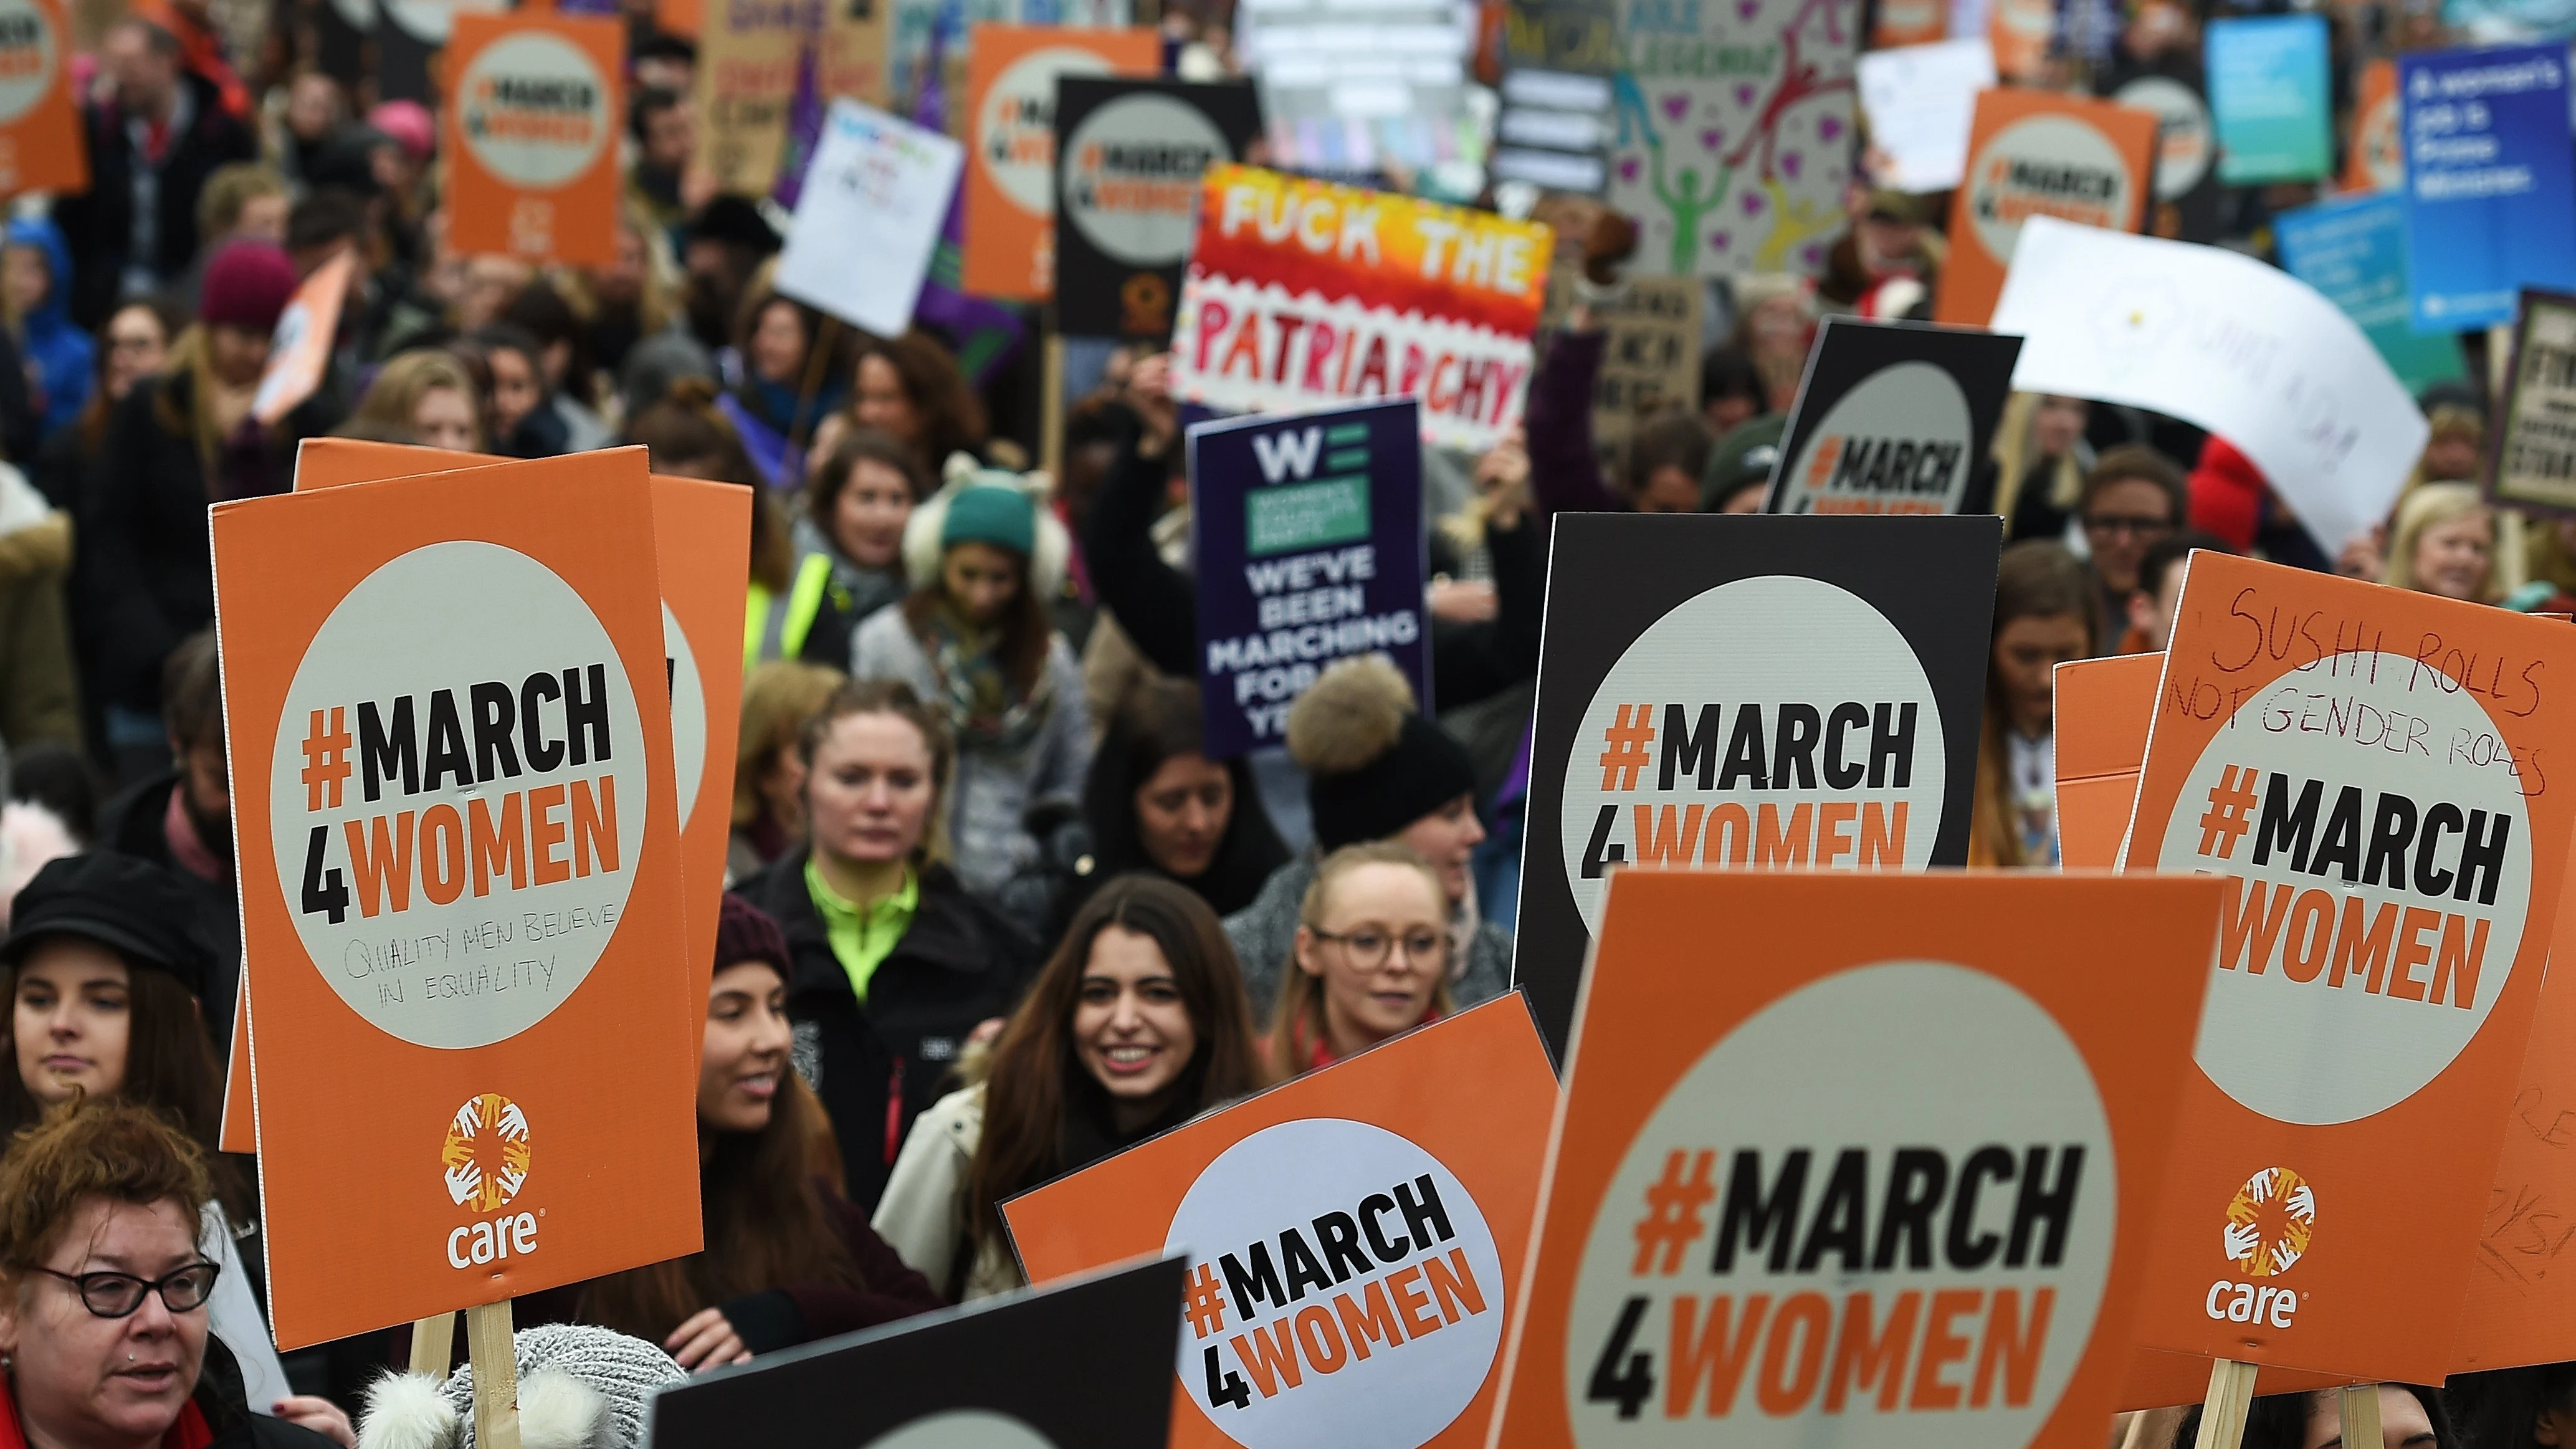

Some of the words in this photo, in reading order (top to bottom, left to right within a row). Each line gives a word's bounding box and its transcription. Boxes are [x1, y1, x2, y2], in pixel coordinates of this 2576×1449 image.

[1221, 184, 1381, 267] FUCK
[1415, 219, 1531, 295] THE
[1195, 300, 1524, 426] PATRIARCHY
[1807, 435, 1961, 494] #MARCH
[1244, 544, 1375, 596] WE'VE
[1258, 584, 1365, 628] BEEN
[1206, 610, 1419, 674] MARCHING
[2212, 588, 2382, 684] SUSHI
[2409, 633, 2545, 717] ROLLS
[301, 663, 612, 812] #MARCH
[1599, 701, 1918, 791] #MARCH
[2167, 675, 2258, 730] NOT
[2263, 687, 2430, 756] GENDER
[2448, 728, 2545, 796] ROLES
[301, 775, 621, 925] 4WOMEN
[1580, 801, 1910, 879] 4WOMEN
[2197, 763, 2511, 906] #MARCH
[345, 929, 451, 978] QUALITY
[463, 921, 513, 953] MEN
[523, 904, 617, 944] BELIEVE
[376, 977, 404, 1008] IN
[426, 954, 556, 1000] EQUALITY
[2194, 870, 2491, 1010] WOMEN
[1183, 1173, 1456, 1339] #MARCH
[1630, 1142, 2088, 1278] #MARCH
[1203, 1246, 1487, 1410] 4WOMEN
[1584, 1286, 2058, 1422] 4WOMEN
